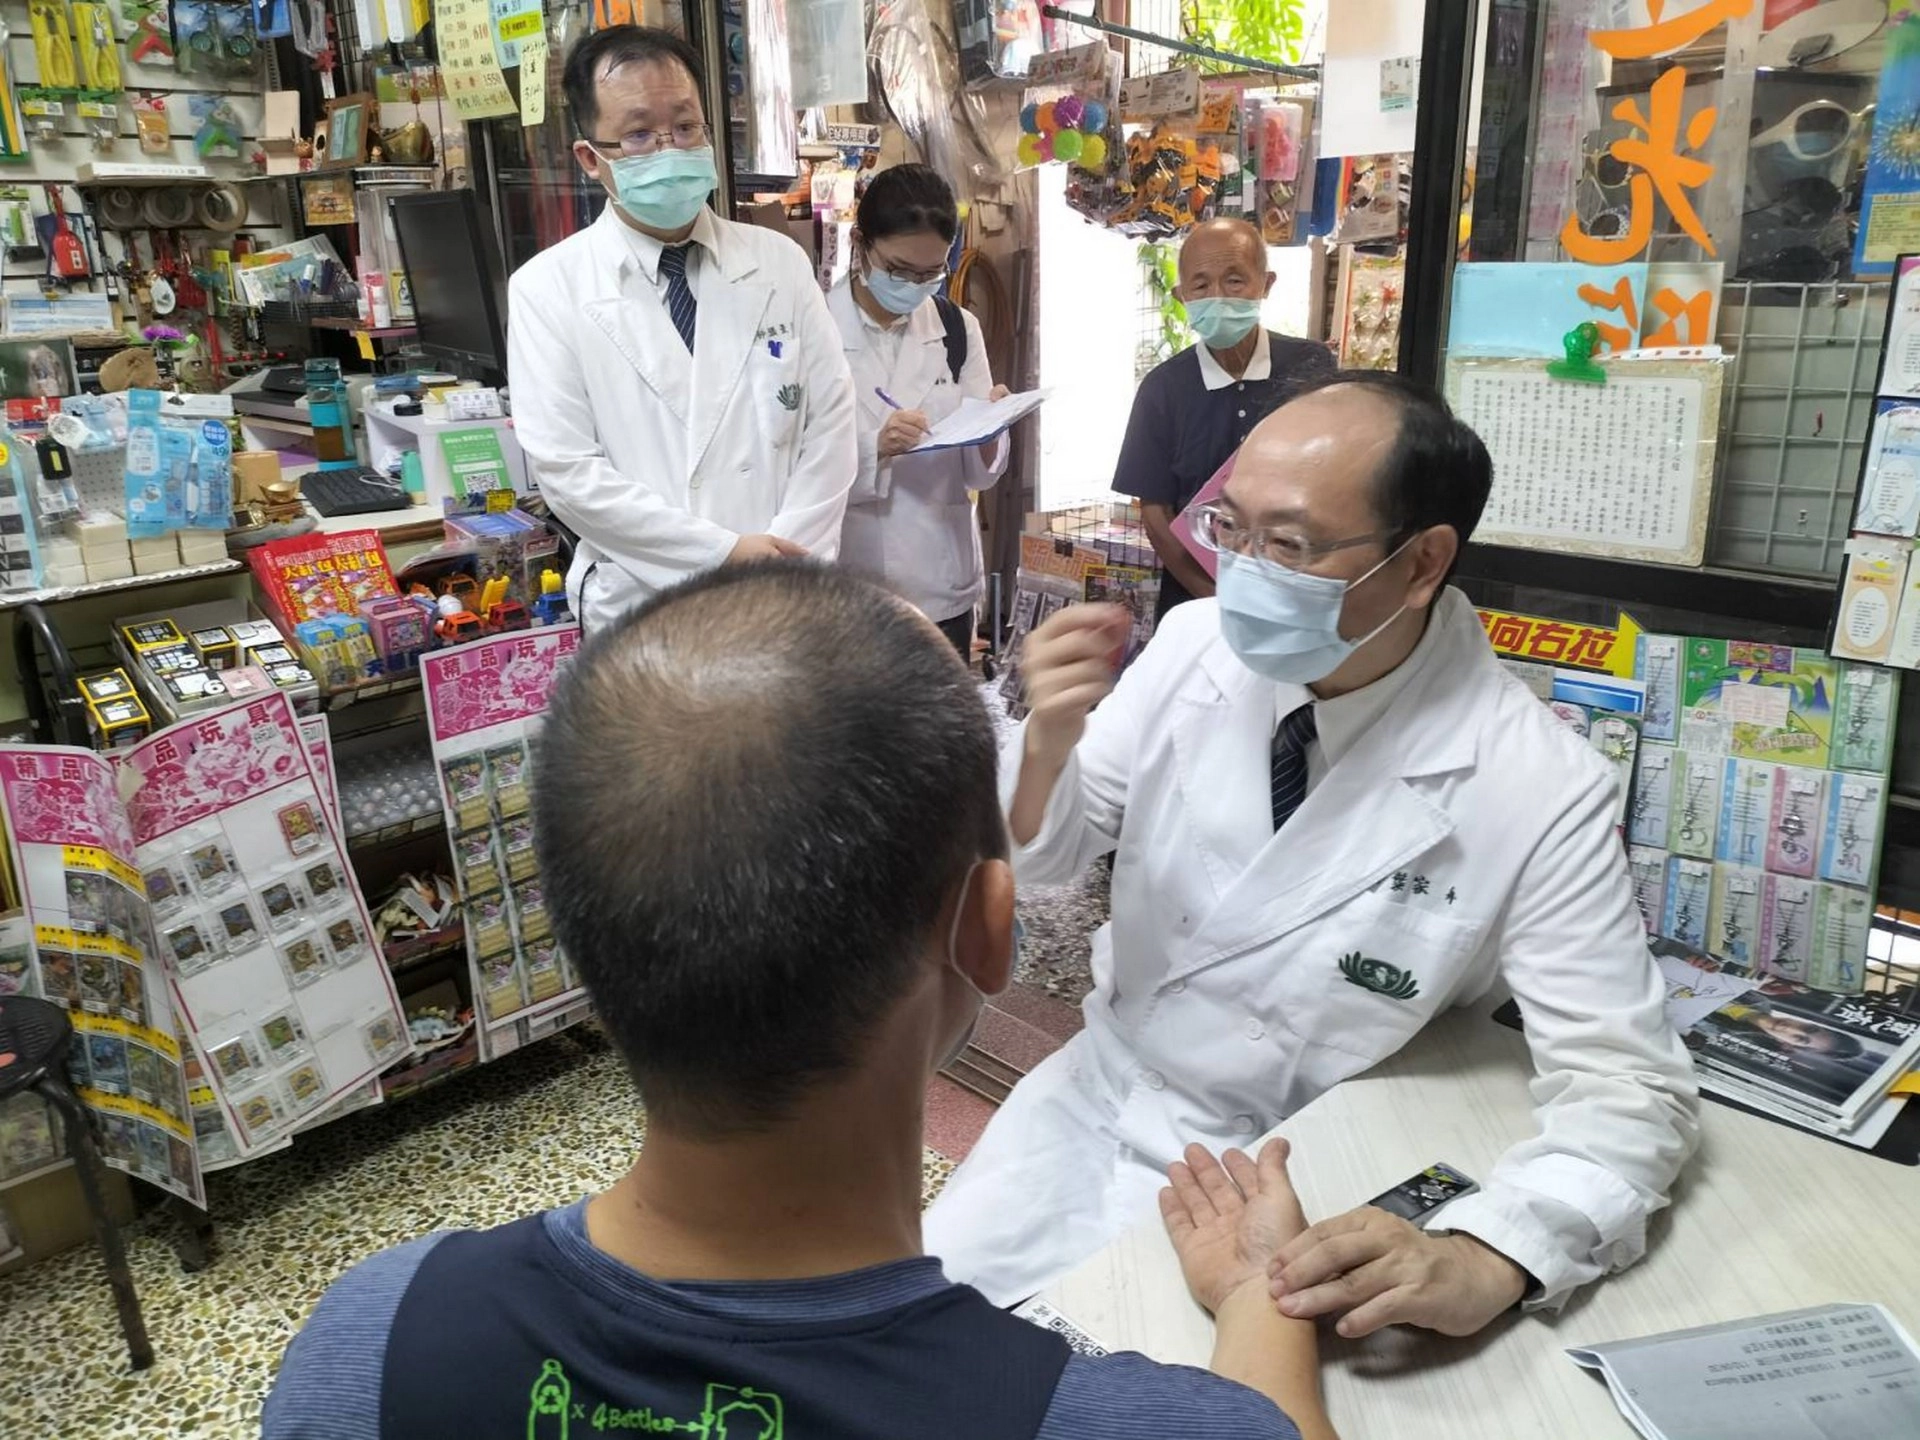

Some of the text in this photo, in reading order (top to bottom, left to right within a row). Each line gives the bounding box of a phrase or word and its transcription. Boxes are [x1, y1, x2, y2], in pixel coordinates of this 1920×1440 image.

[181, 653, 199, 669] 5
[441, 632, 575, 680] 精品玩具
[203, 679, 225, 695] 6
